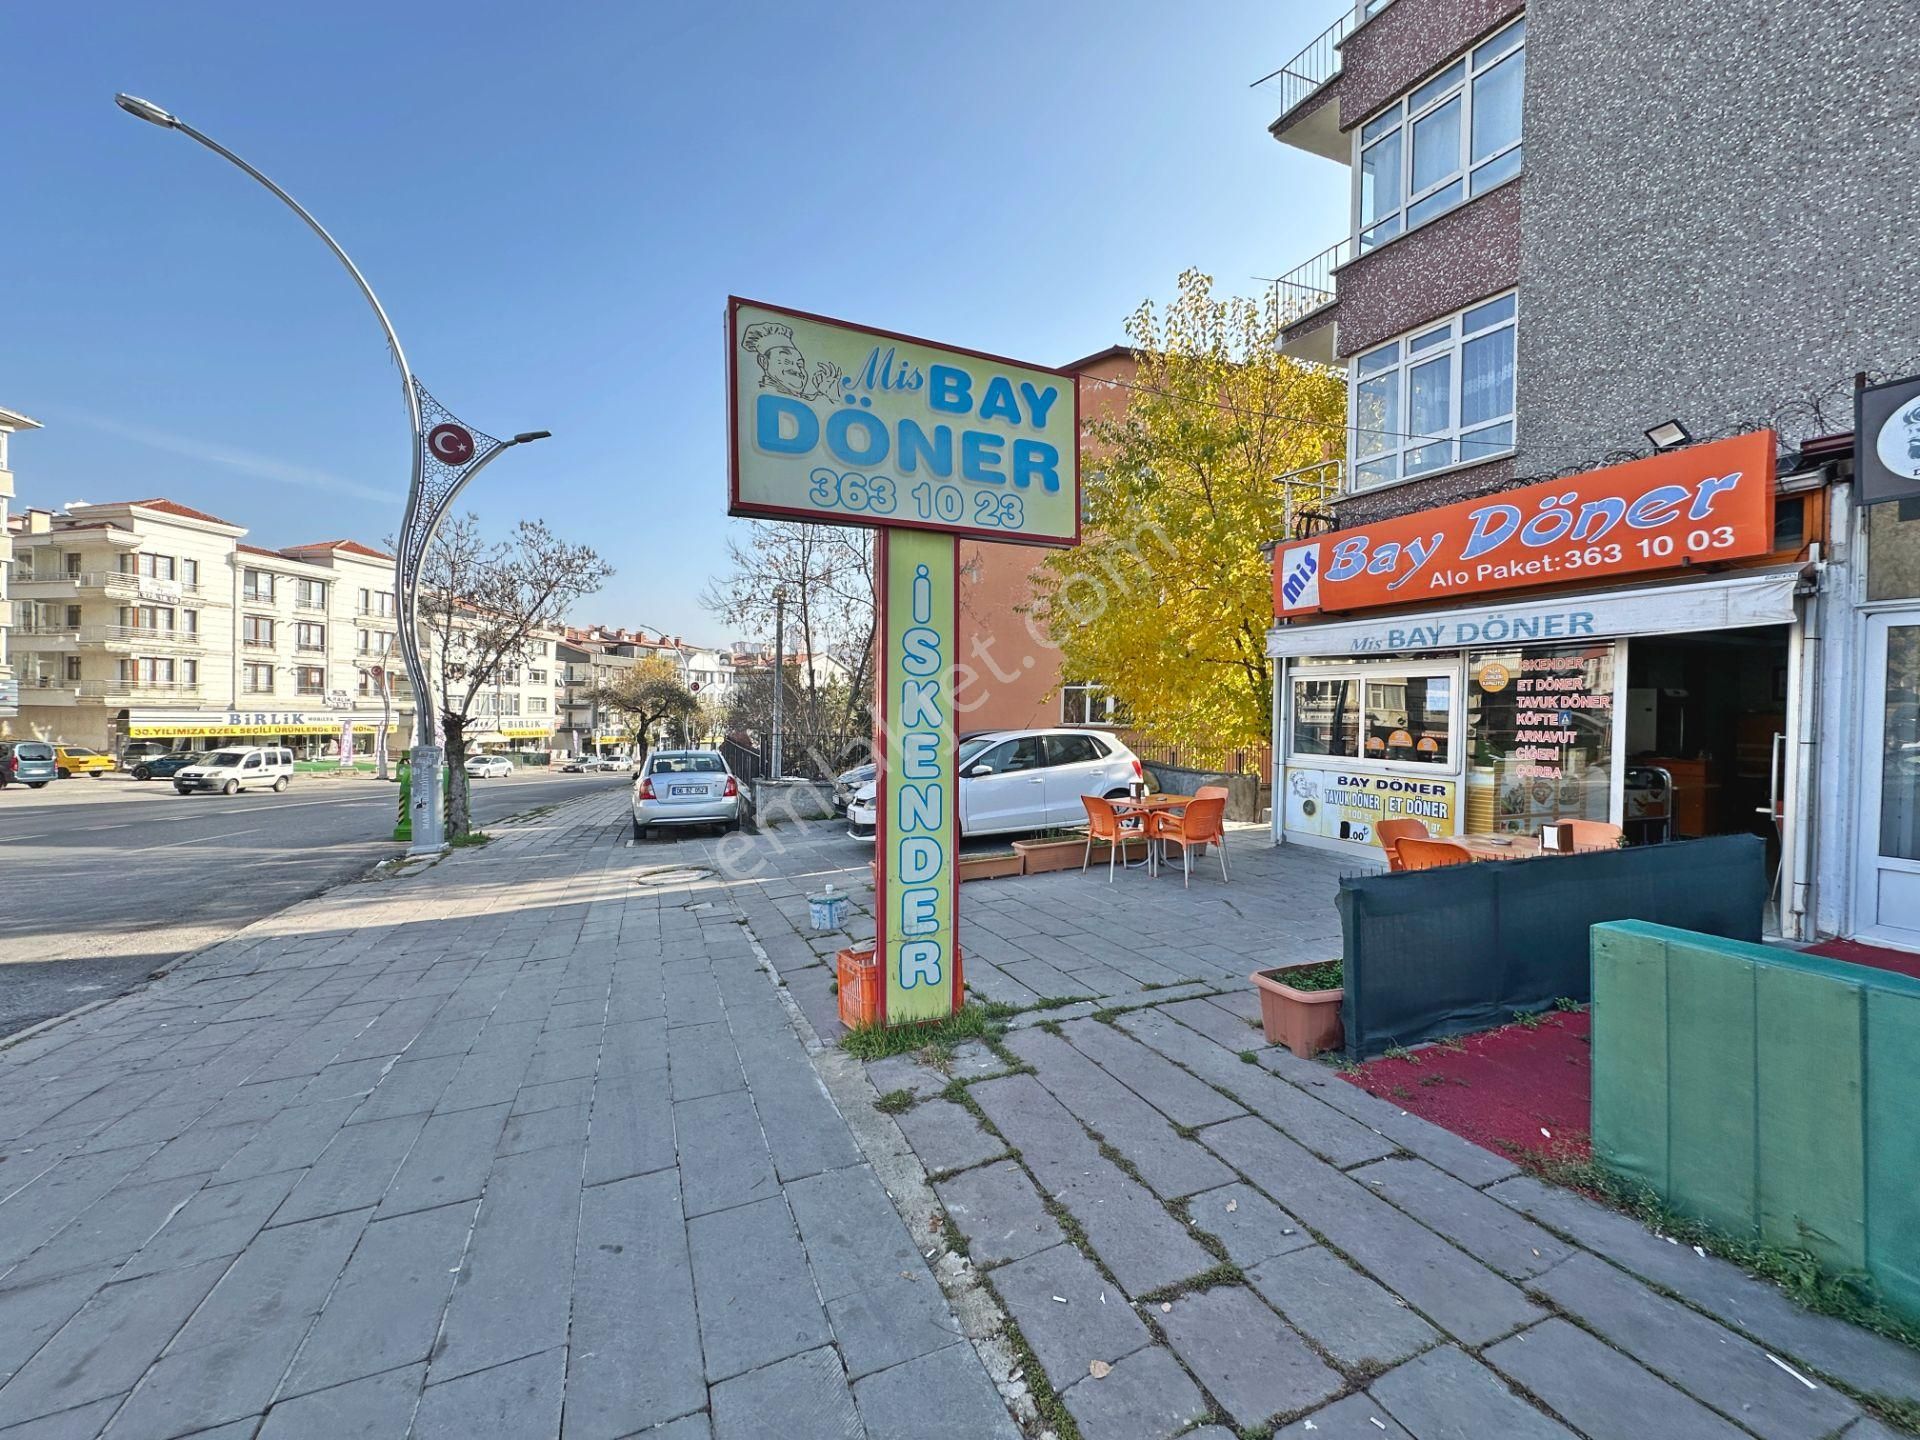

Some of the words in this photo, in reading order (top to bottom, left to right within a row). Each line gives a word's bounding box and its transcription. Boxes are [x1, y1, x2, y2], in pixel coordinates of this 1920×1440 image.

[841, 346, 924, 390] Mis
[929, 364, 1058, 429] BAY
[756, 393, 1060, 493] DÖNER
[809, 467, 897, 514] 363
[911, 482, 964, 522] 10
[974, 490, 1024, 529] 23
[1324, 535, 1444, 590] Bay
[1459, 472, 1743, 560] Döner
[1429, 569, 1469, 589] Alo
[1636, 535, 1674, 558] 10
[1687, 526, 1735, 551] 03
[1351, 636, 1383, 650] Mis
[1388, 624, 1446, 649] BAY
[1456, 611, 1594, 644] DÖNER
[1516, 679, 1534, 691] ET
[1536, 677, 1583, 691] DÖNER
[1516, 695, 1558, 709] TAVUK
[1560, 693, 1611, 709] DÖNER
[1516, 710, 1558, 726] KÖFTE
[1515, 730, 1578, 744] ARNAVUT
[902, 564, 943, 990] İSKENDER
[1515, 764, 1562, 780] ÇORBA
[1337, 776, 1370, 788] BAY
[1376, 779, 1446, 796] DÖNER
[1325, 789, 1350, 807] TAVUK
[1351, 790, 1380, 810] DÖNER
[1389, 796, 1403, 813] ET
[1406, 796, 1449, 819] DÖNER
